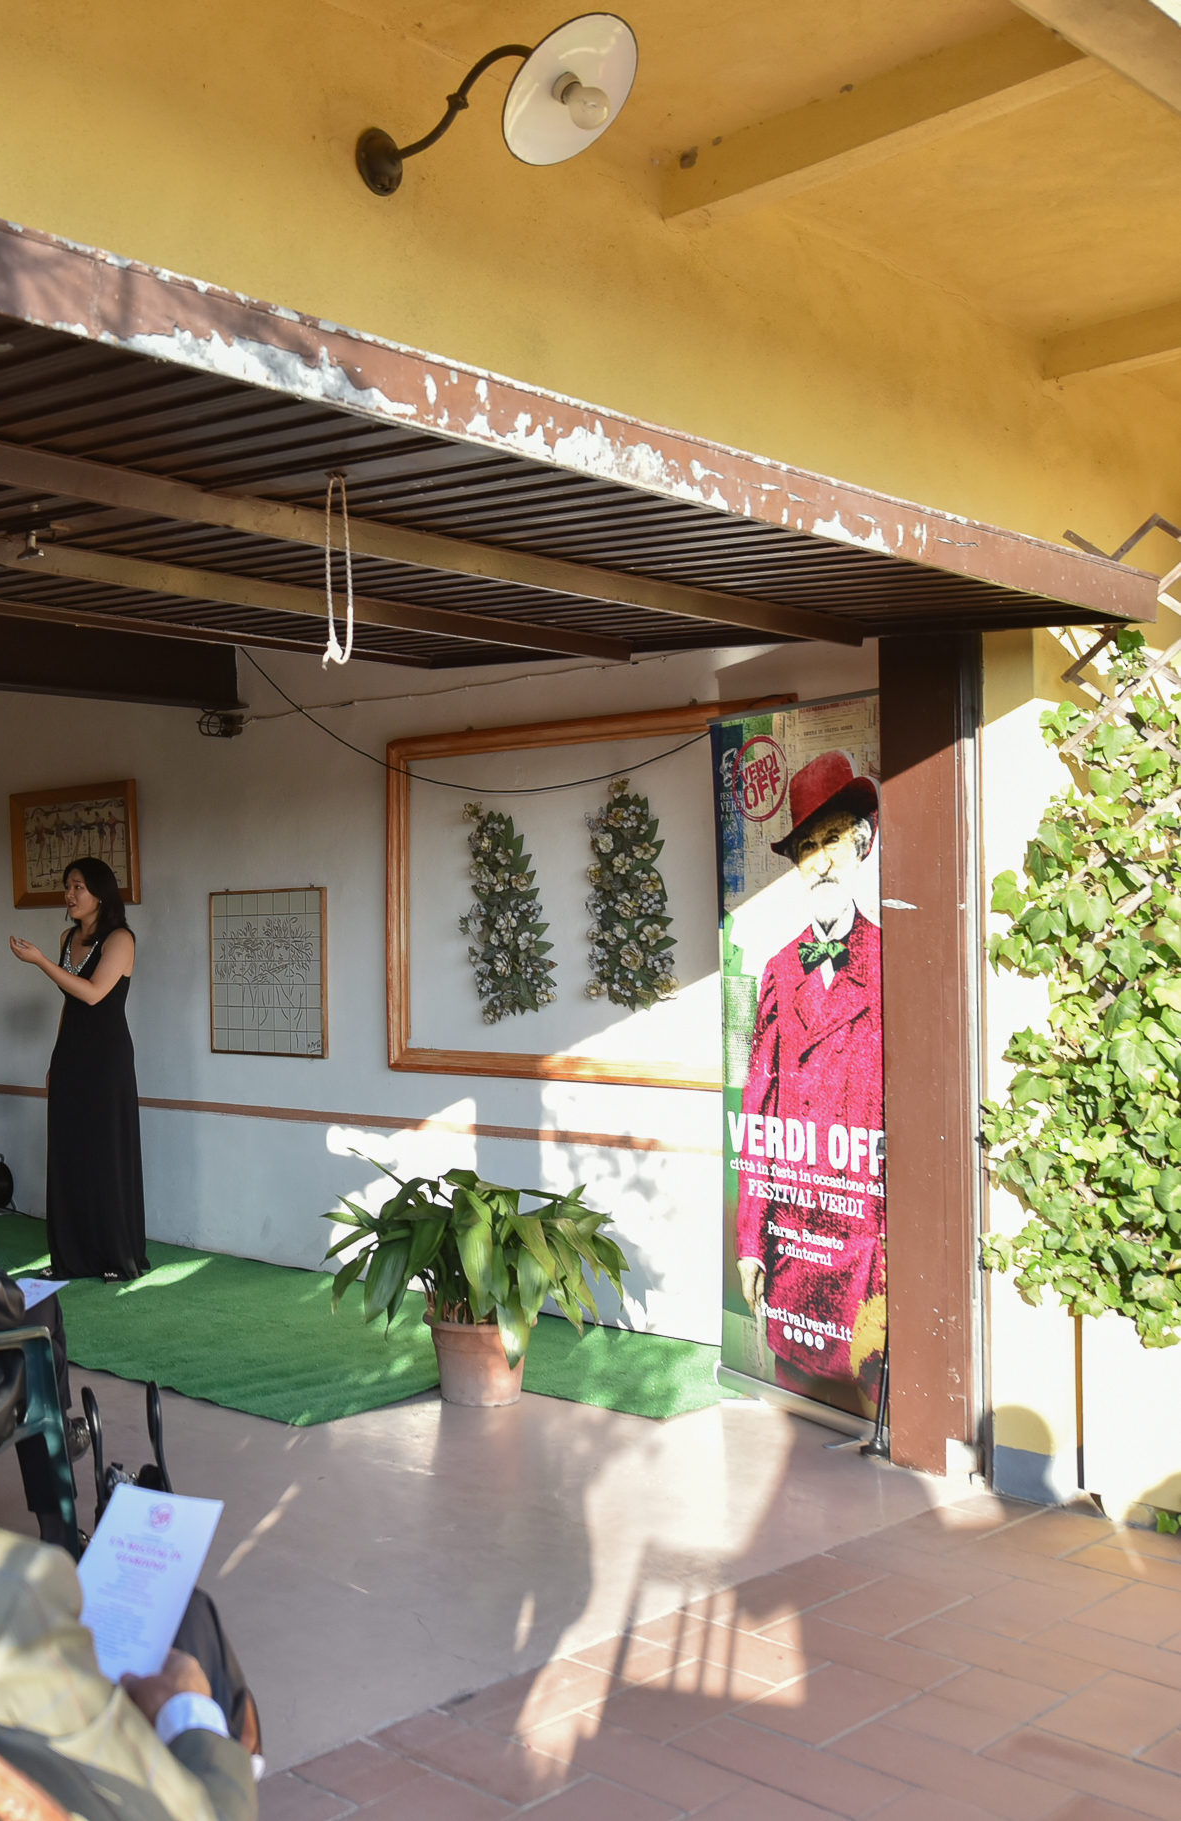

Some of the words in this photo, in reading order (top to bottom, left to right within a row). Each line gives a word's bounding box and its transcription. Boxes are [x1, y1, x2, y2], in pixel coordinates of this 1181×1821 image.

[740, 751, 779, 784] VERDI
[744, 767, 781, 809] OFF
[727, 1111, 817, 1165] VERDI
[729, 1156, 756, 1173] città
[756, 1160, 773, 1176] in
[771, 1164, 797, 1181] festa
[798, 1168, 812, 1184] in
[812, 1174, 865, 1194] occasione
[866, 1181, 886, 1197] del
[747, 1178, 817, 1209] FESTIVAL
[818, 1191, 865, 1219] VERDI
[767, 1220, 801, 1243] Parma,
[802, 1228, 845, 1251] Busseto
[777, 1244, 785, 1255] e
[785, 1243, 833, 1267] dintorni
[760, 1299, 853, 1342] festivalverdi.it
